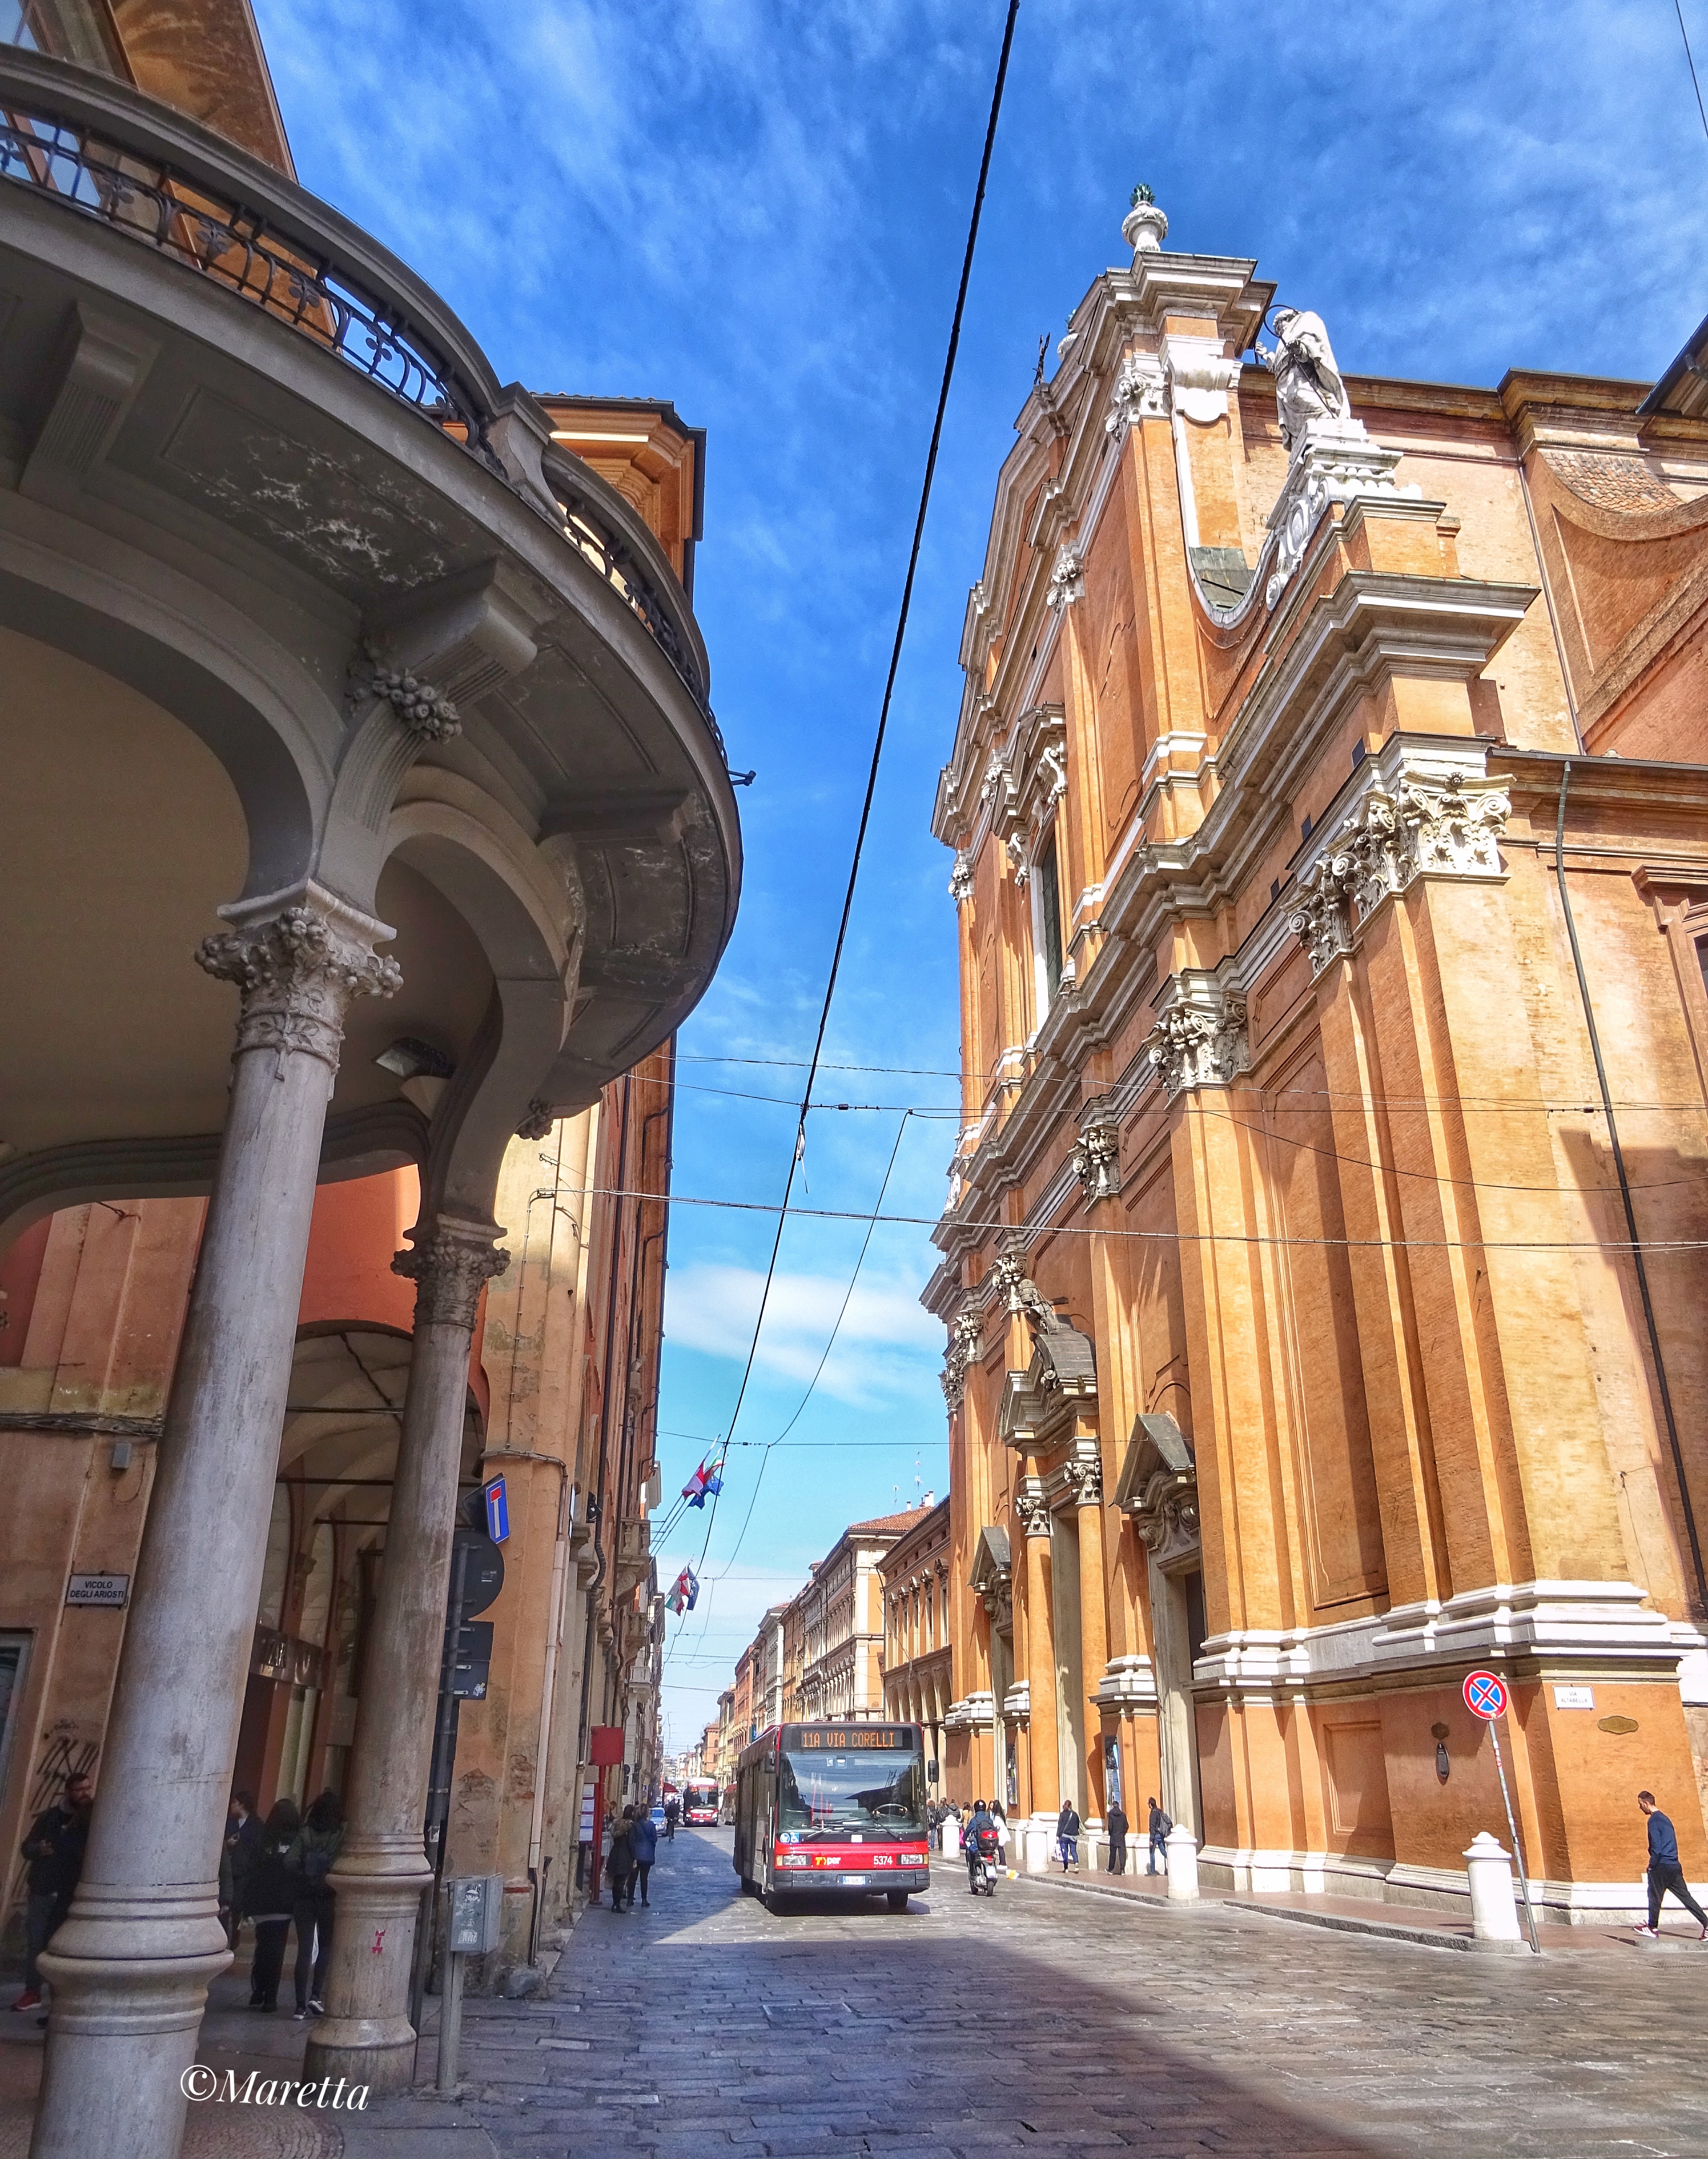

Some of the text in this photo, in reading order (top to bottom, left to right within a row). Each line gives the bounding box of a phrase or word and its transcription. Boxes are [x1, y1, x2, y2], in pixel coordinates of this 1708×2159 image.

[803, 1732, 894, 1747] 11A VIA CORELLI
[873, 1855, 893, 1865] 5374
